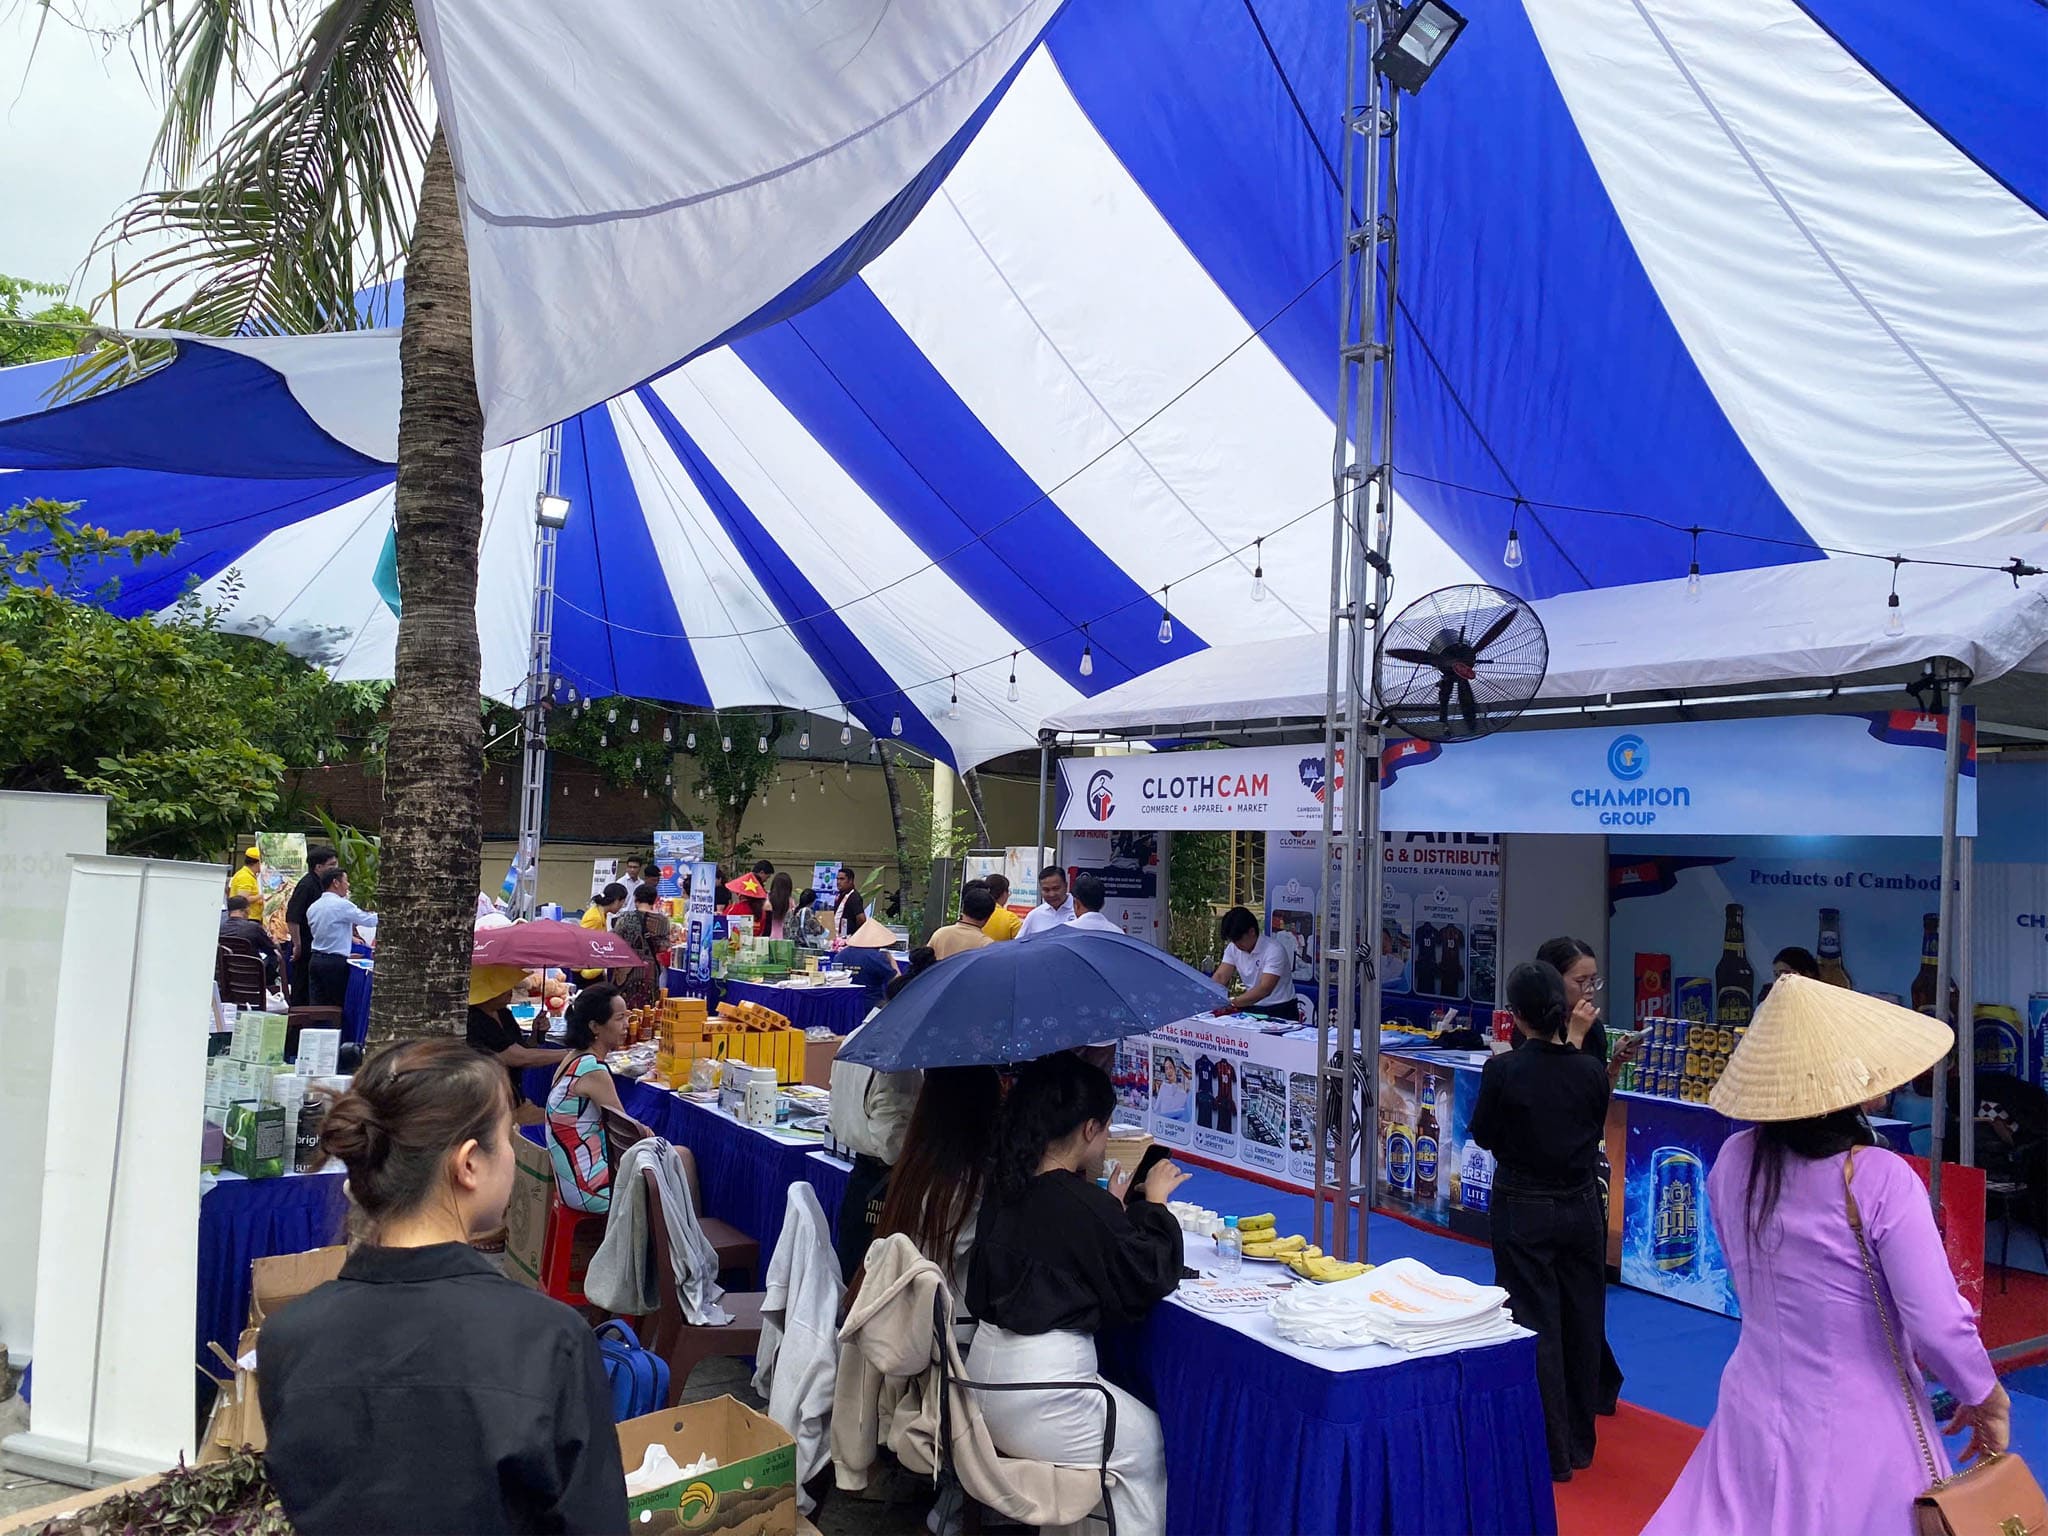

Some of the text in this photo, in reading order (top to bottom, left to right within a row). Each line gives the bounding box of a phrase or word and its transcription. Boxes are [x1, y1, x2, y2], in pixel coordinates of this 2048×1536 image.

[1142, 773, 1269, 799] CLOTHCAM
[1141, 803, 1269, 814] COMMERCE APPAREL MARKET
[1599, 811, 1657, 825] GROUP
[1398, 848, 1409, 862] &
[1423, 867, 1472, 877] EXPANDING
[1750, 869, 1960, 892] Products of Camboda
[1180, 1037, 1217, 1051] PRODUCTION
[1218, 1045, 1249, 1057] PARTNERS
[1462, 1165, 1492, 1184] GREET
[1467, 1188, 1486, 1201] LITE
